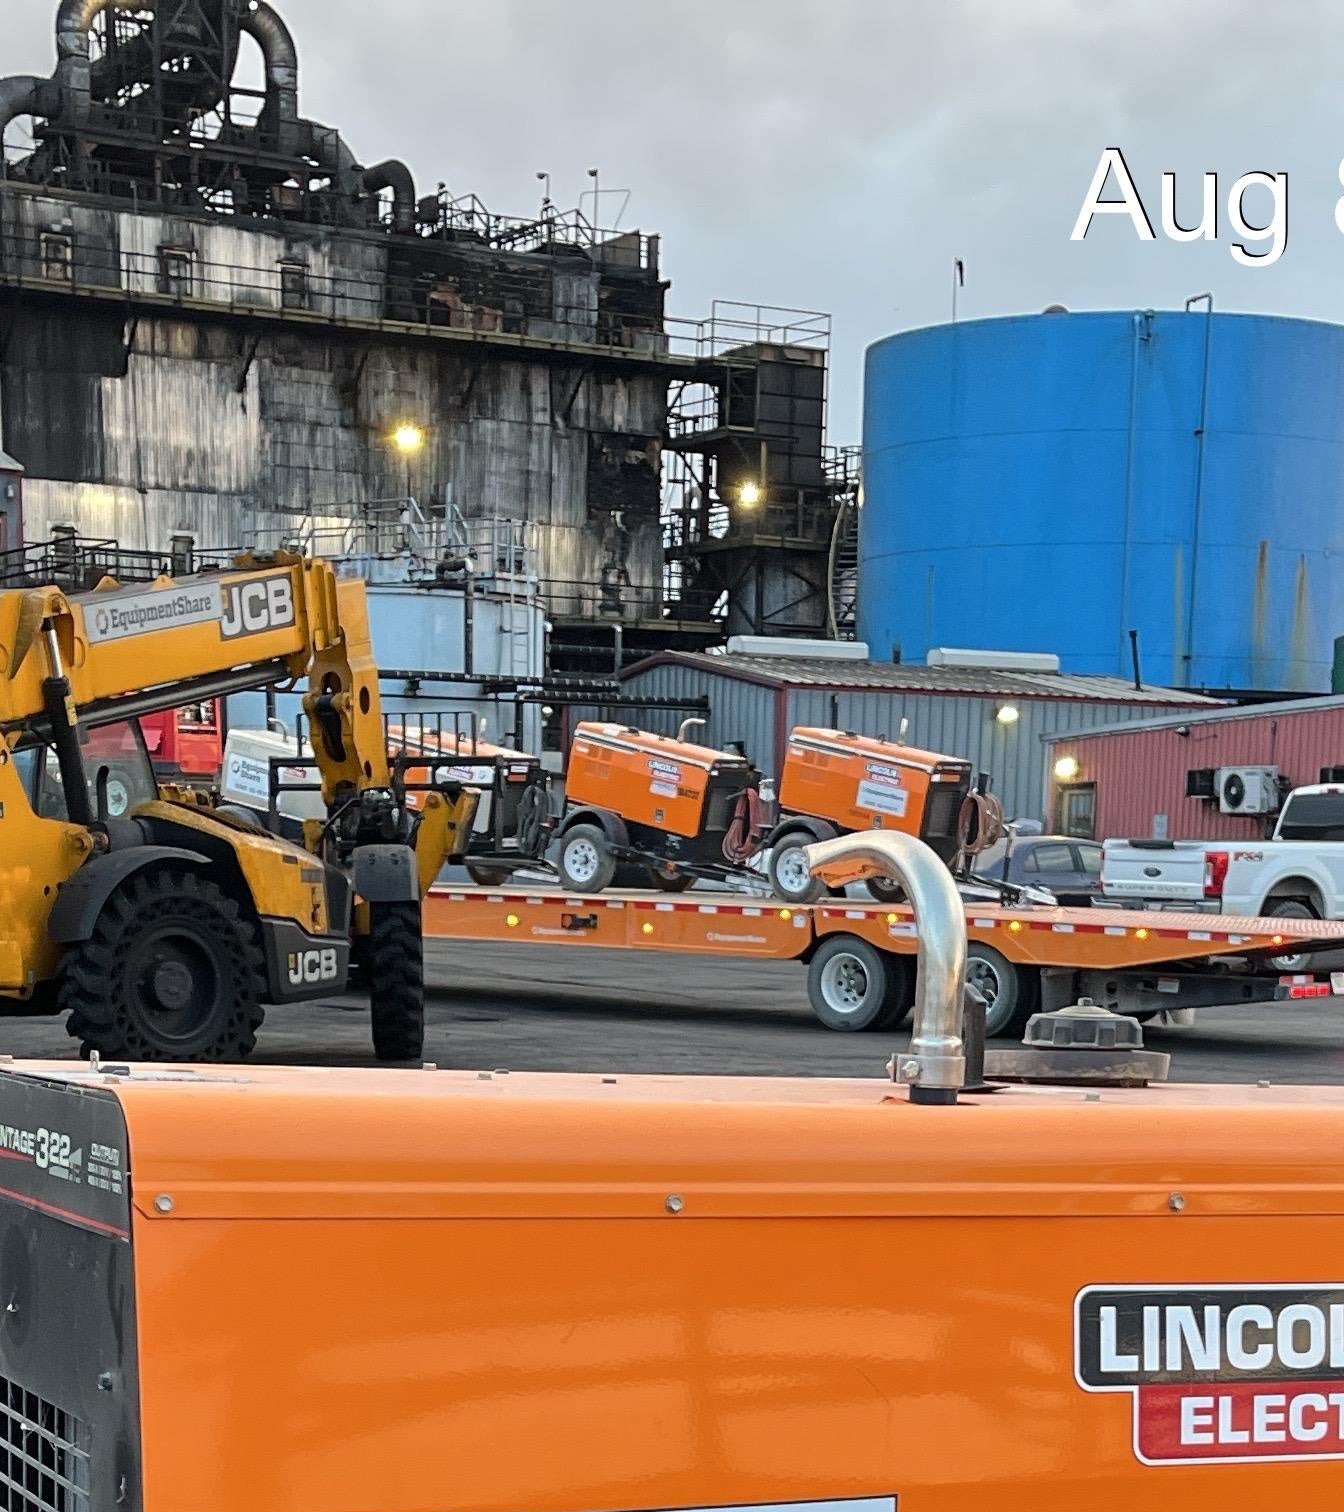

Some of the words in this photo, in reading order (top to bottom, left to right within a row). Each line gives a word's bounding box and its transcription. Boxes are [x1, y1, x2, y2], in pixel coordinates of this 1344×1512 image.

[110, 595, 211, 629] EquipmentShare
[221, 578, 294, 637] JCB
[288, 948, 337, 984] JCB
[35, 1128, 71, 1169] 322
